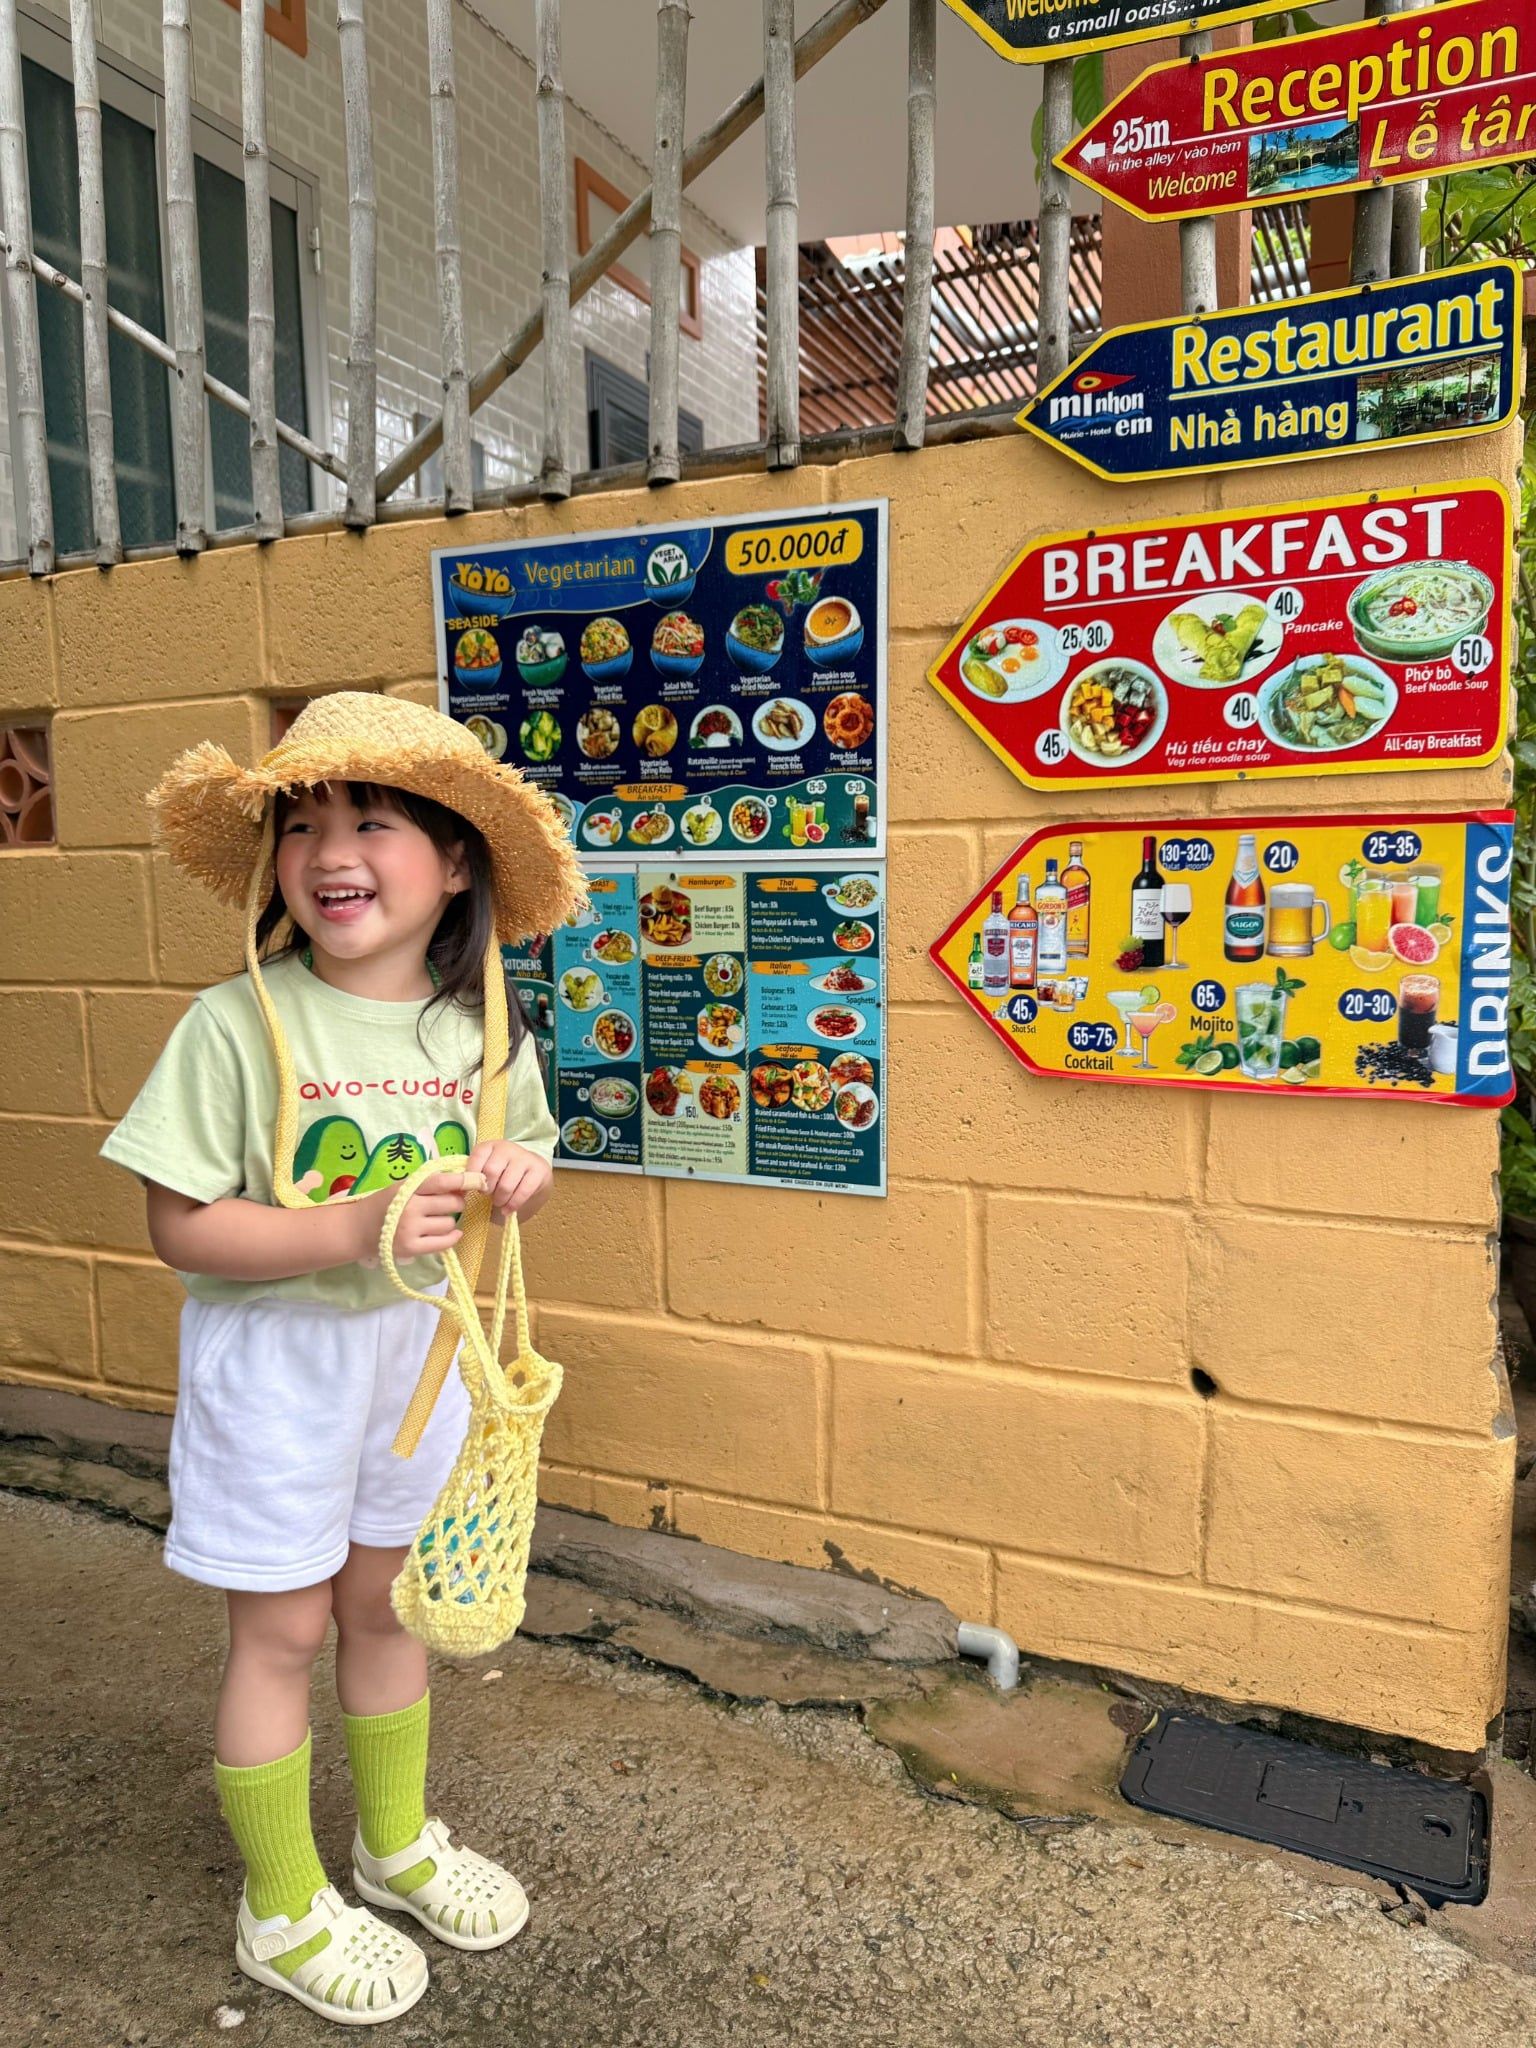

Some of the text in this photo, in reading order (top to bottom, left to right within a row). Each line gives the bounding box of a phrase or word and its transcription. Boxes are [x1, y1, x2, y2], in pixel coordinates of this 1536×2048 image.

[1048, 25, 1060, 39] a
[1065, 8, 1120, 36] small
[1203, 25, 1518, 131] Reception
[1112, 115, 1170, 154] 25m
[1369, 99, 1442, 168] Lễ
[1107, 160, 1119, 173] in
[1122, 157, 1142, 170] the
[1145, 152, 1175, 167] alley
[1185, 145, 1208, 160] vào
[1148, 170, 1237, 200] Welcome
[1171, 278, 1504, 390] Restaurant
[1115, 417, 1152, 436] em
[1169, 402, 1349, 452] Nhà hàng
[739, 528, 848, 567] 50.000đ
[1043, 500, 1460, 602] BREAKFAST
[524, 554, 636, 590] Vegetarian
[448, 615, 499, 631] SEASIDE
[1284, 619, 1344, 635] Pancake
[1405, 679, 1488, 694] Beef Noodle Soup
[1226, 738, 1268, 754] chay
[1384, 735, 1482, 752] All-day Breakfast
[1168, 753, 1271, 768] Veg rice noodle soup
[627, 785, 673, 794] BREAKFAST
[688, 878, 726, 887] Hamburger
[1469, 845, 1514, 1076] DRINKS
[846, 996, 875, 1006] Spaghetti
[1012, 1025, 1026, 1033] Shot
[1190, 1015, 1233, 1035] Mojito
[775, 1045, 802, 1053] Seafood
[853, 1038, 877, 1046] Gnocchi
[1065, 1054, 1114, 1070] Cocktail
[300, 1076, 474, 1105] avo-cudde
